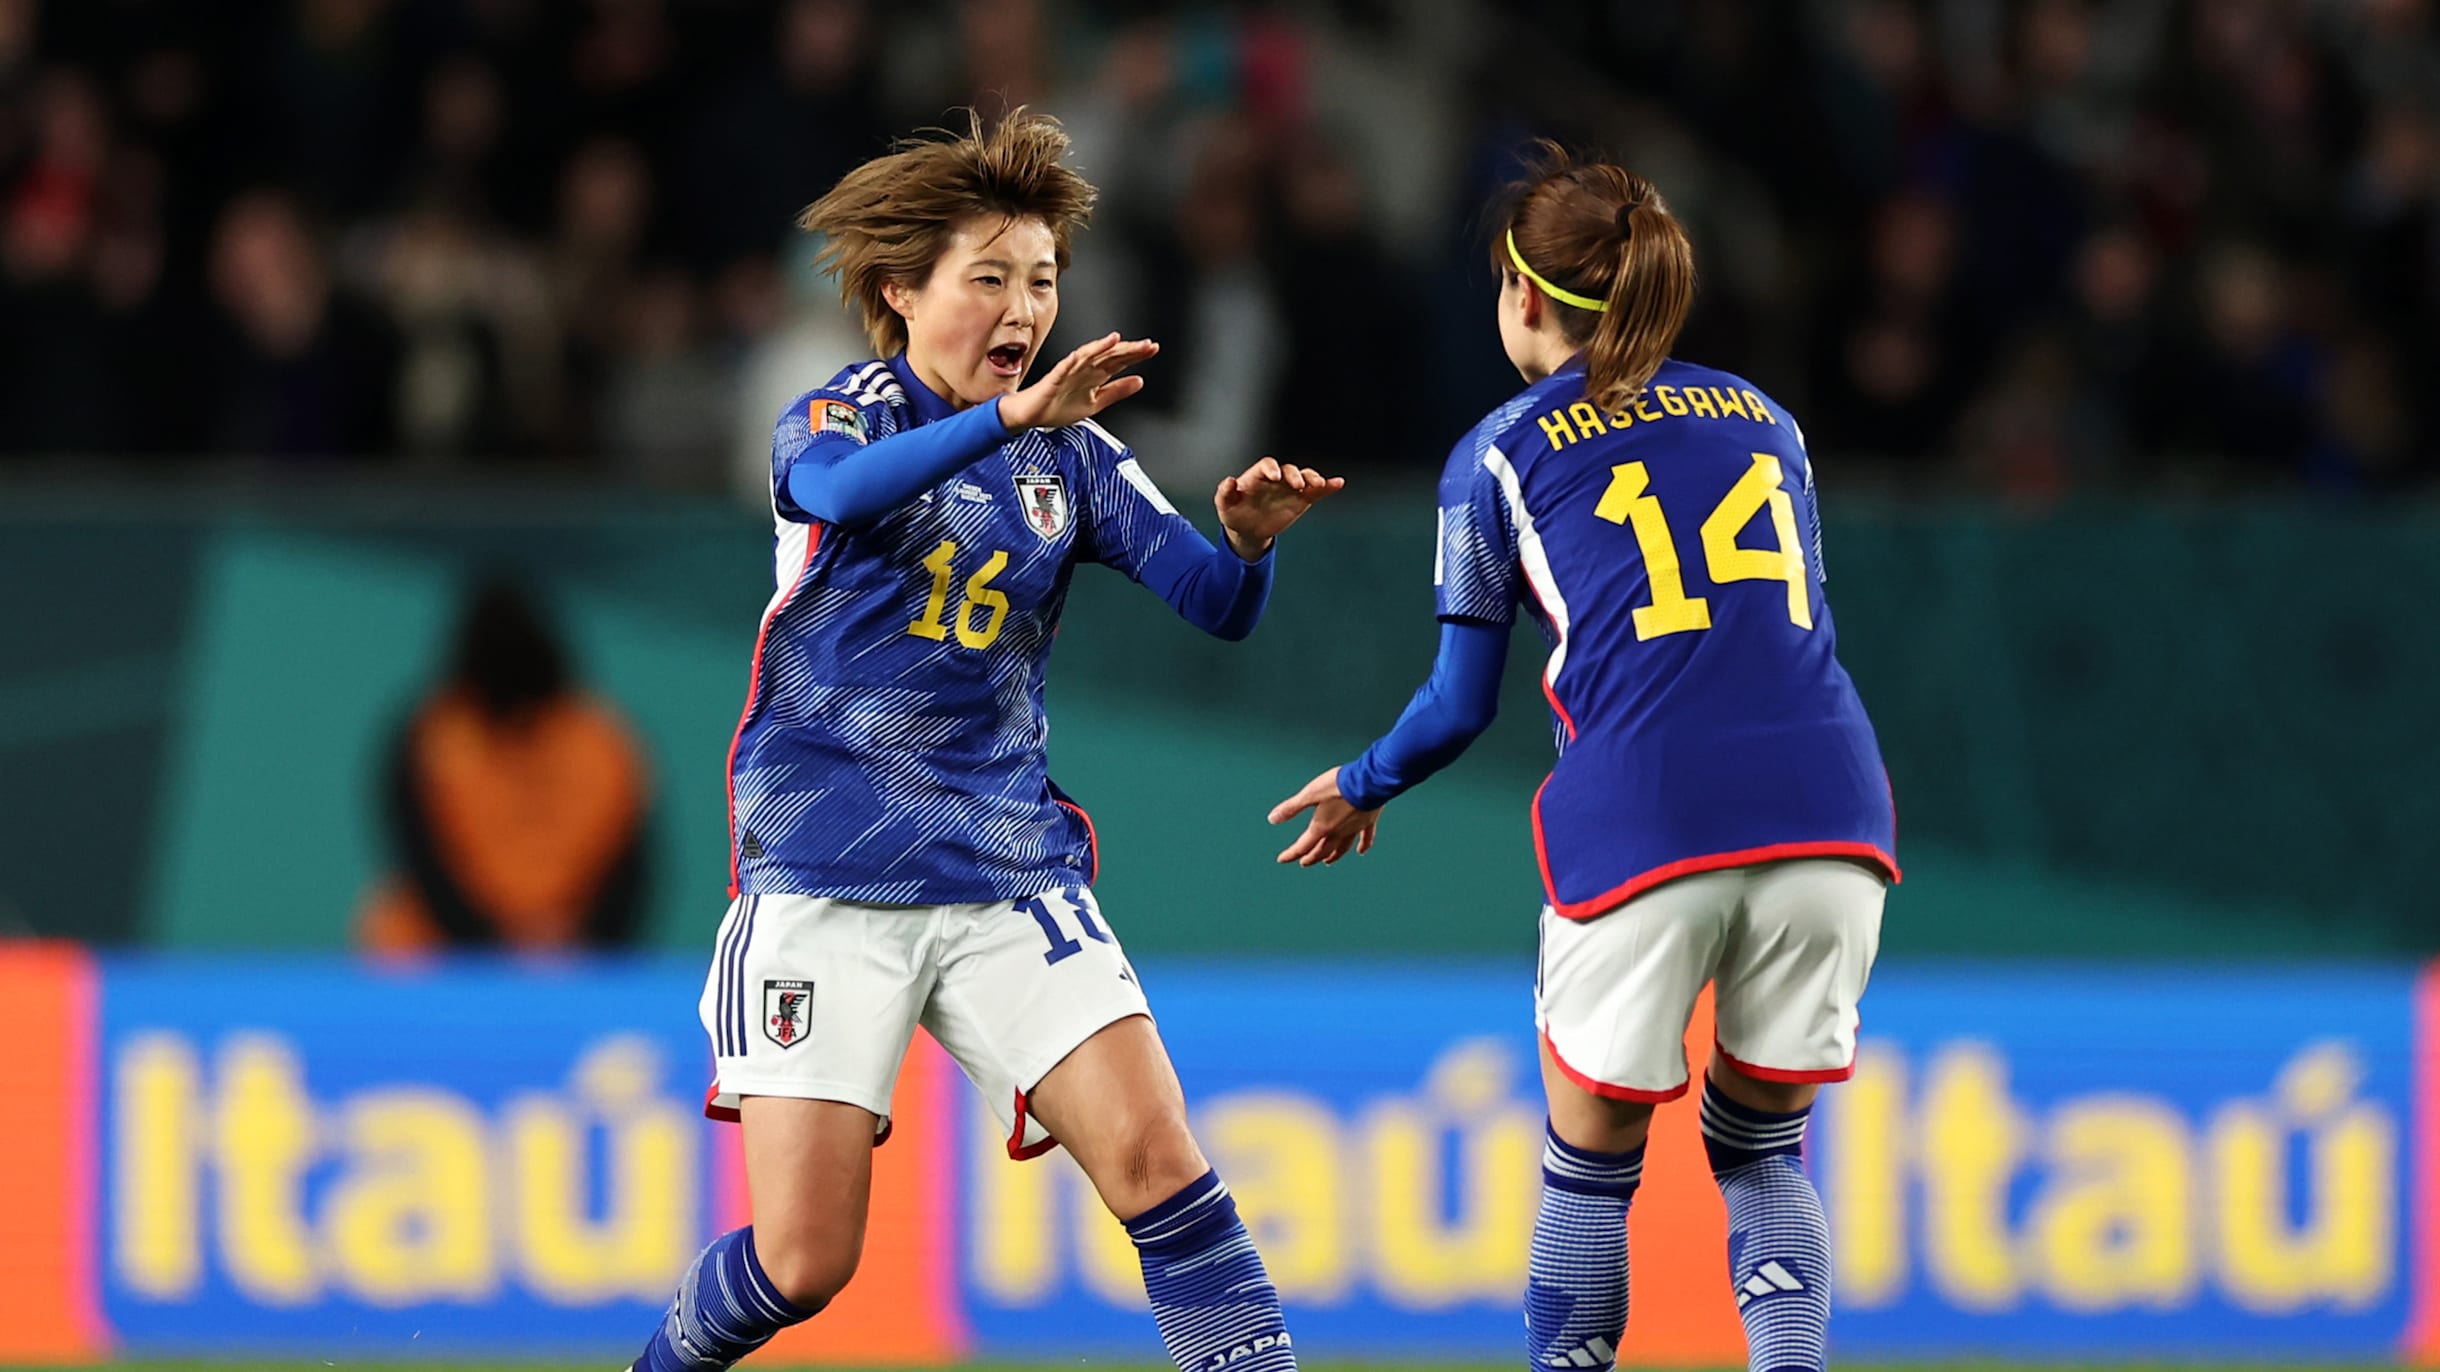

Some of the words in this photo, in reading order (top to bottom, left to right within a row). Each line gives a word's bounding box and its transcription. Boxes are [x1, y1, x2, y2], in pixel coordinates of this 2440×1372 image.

[907, 540, 1010, 650] 16
[1594, 452, 1814, 642] 14
[775, 981, 803, 989] JAPAN
[775, 1027, 797, 1038] JFA
[120, 1035, 693, 1304] Itaú
[1829, 1040, 2391, 1309] Itaú
